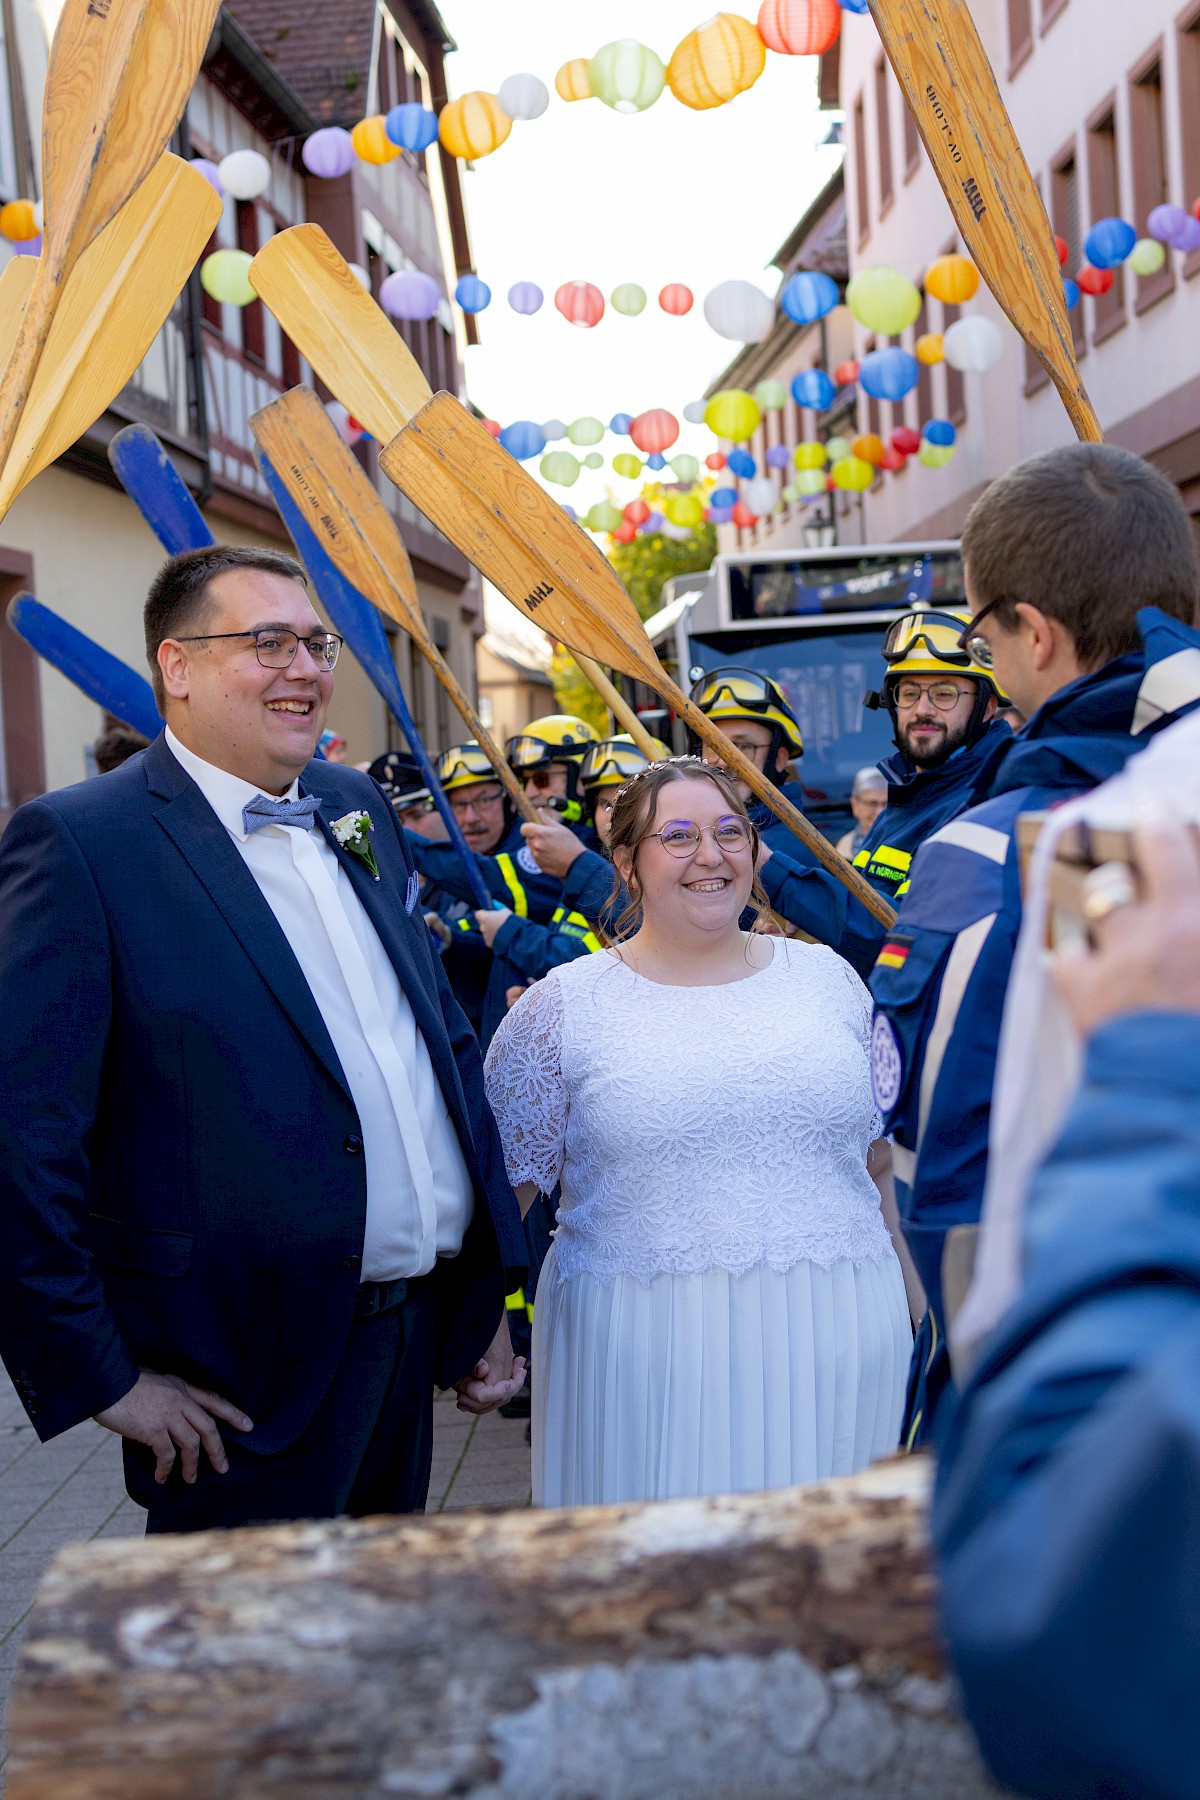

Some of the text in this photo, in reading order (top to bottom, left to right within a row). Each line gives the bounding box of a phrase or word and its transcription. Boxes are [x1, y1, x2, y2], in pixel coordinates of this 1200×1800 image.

[962, 178, 986, 222] THW
[320, 515, 339, 539] THW
[524, 581, 554, 612] THW
